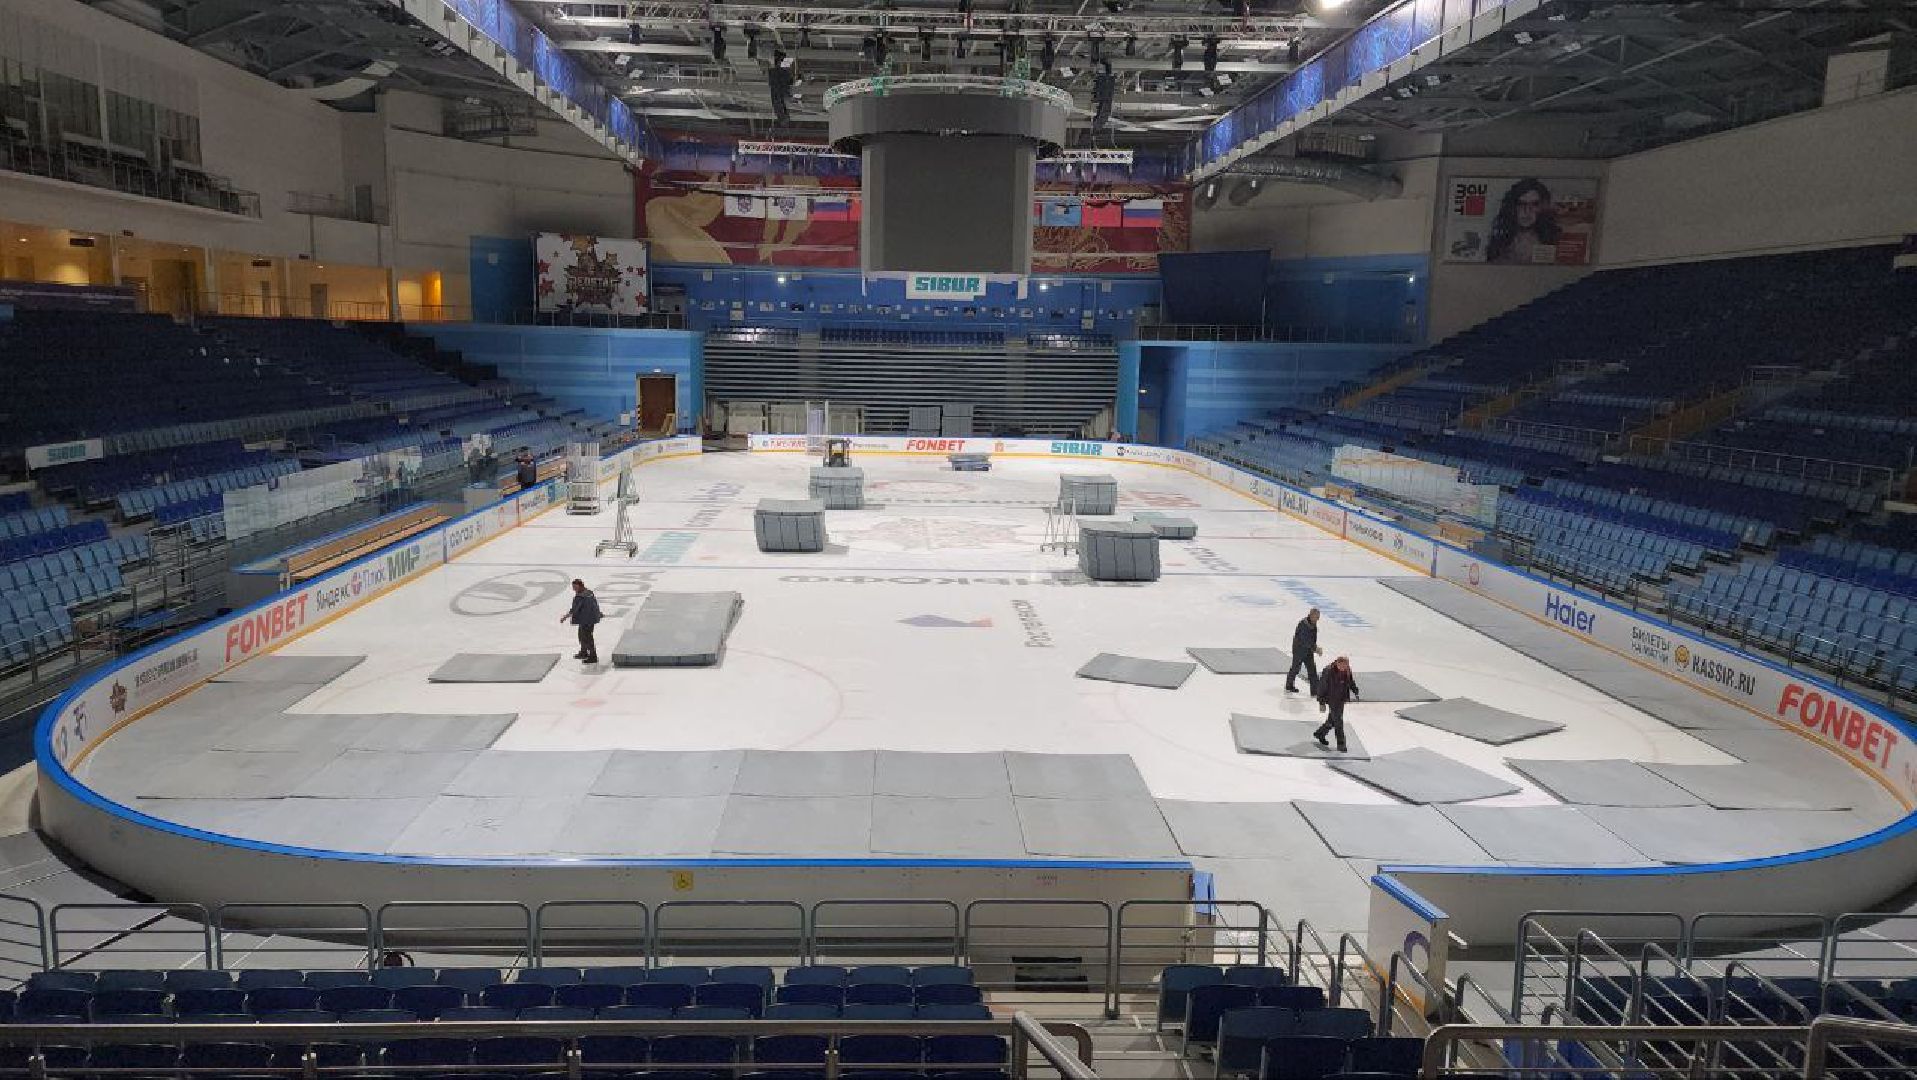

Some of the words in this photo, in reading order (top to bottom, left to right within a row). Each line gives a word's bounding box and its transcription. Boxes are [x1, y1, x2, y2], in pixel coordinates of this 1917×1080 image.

[915, 276, 980, 293] SIBUR
[906, 438, 966, 452] FONBET
[1050, 441, 1103, 456] SIBUR
[387, 544, 421, 582] МИР
[225, 595, 309, 663] FONBET
[1544, 592, 1596, 636] Haier
[1632, 625, 1671, 652] БИЛЕТЫ
[1692, 654, 1756, 696] KASSIR.RU
[1776, 683, 1898, 770] FONBET
